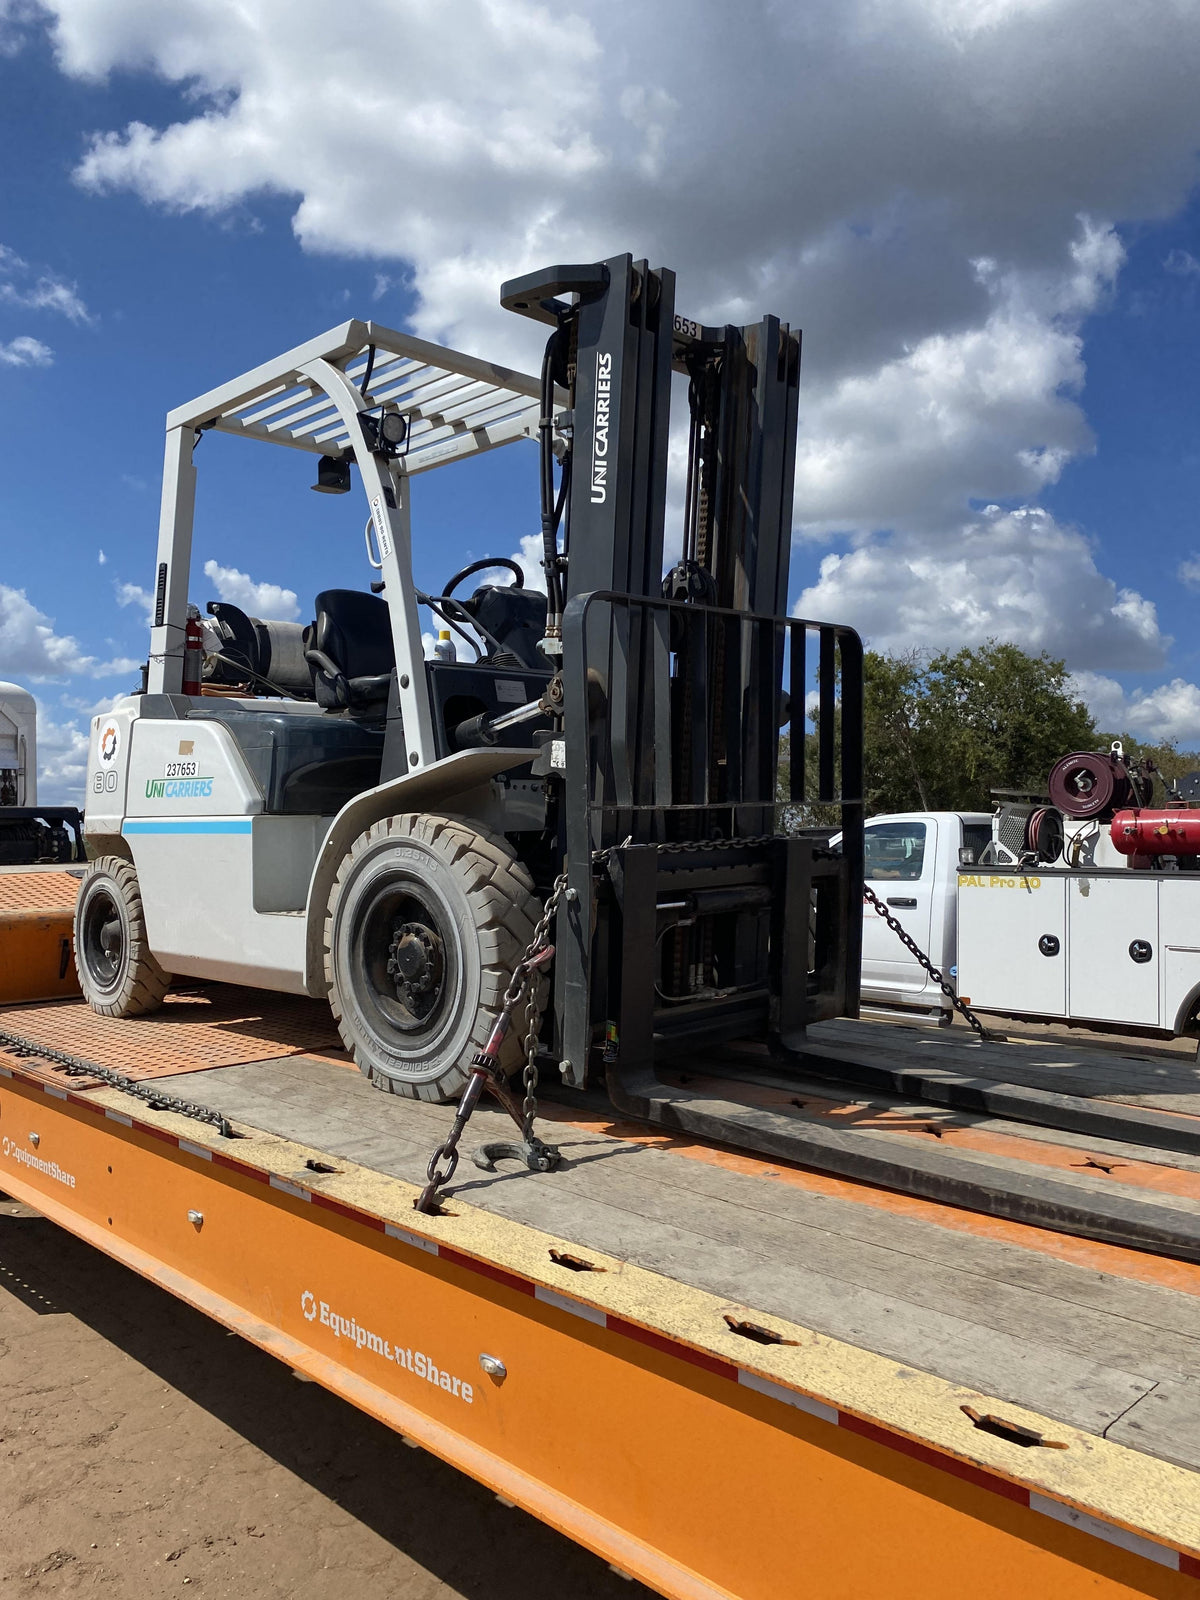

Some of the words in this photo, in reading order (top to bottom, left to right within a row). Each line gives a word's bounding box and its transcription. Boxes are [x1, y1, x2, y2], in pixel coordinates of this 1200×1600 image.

[166, 762, 197, 777] 237653
[93, 770, 118, 794] 80
[959, 874, 986, 888] PAL
[989, 875, 1015, 888] Pro
